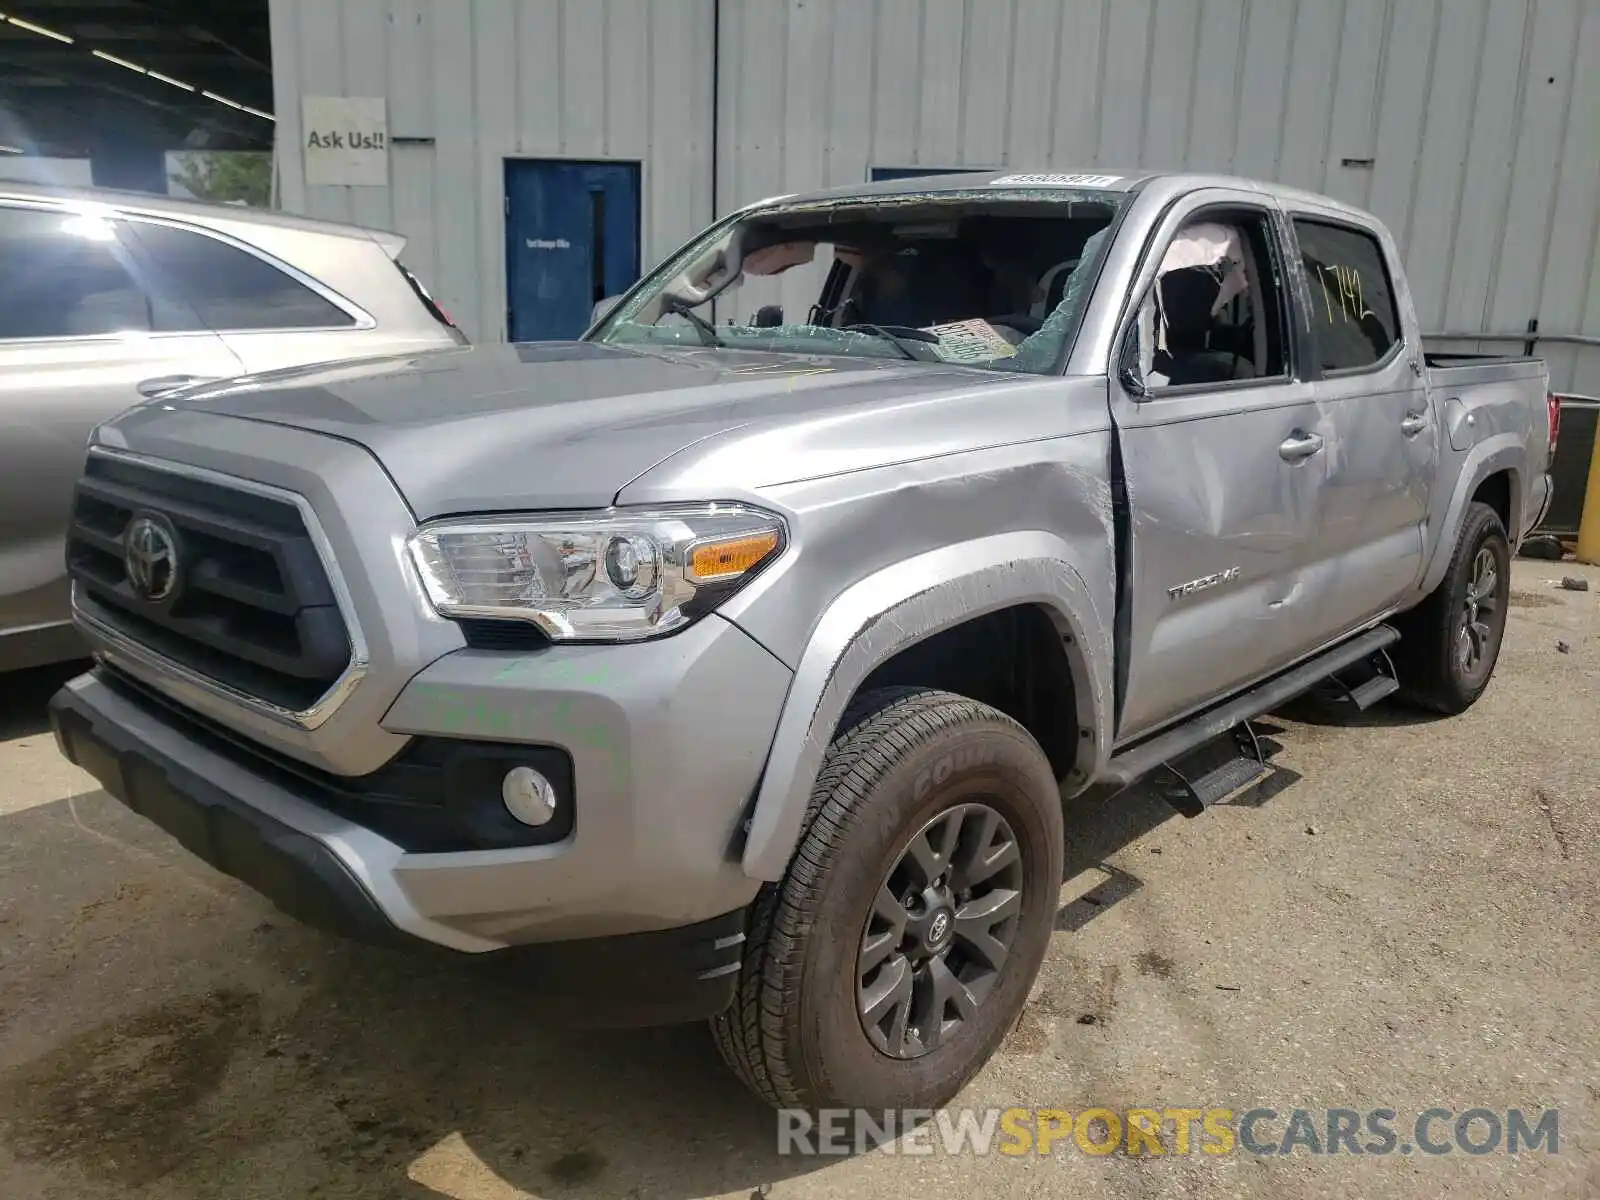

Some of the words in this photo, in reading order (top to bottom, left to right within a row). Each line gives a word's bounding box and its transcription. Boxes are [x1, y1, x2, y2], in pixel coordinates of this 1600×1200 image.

[307, 130, 343, 149] Ask
[348, 131, 384, 150] Us!!
[1316, 264, 1376, 324] 1742
